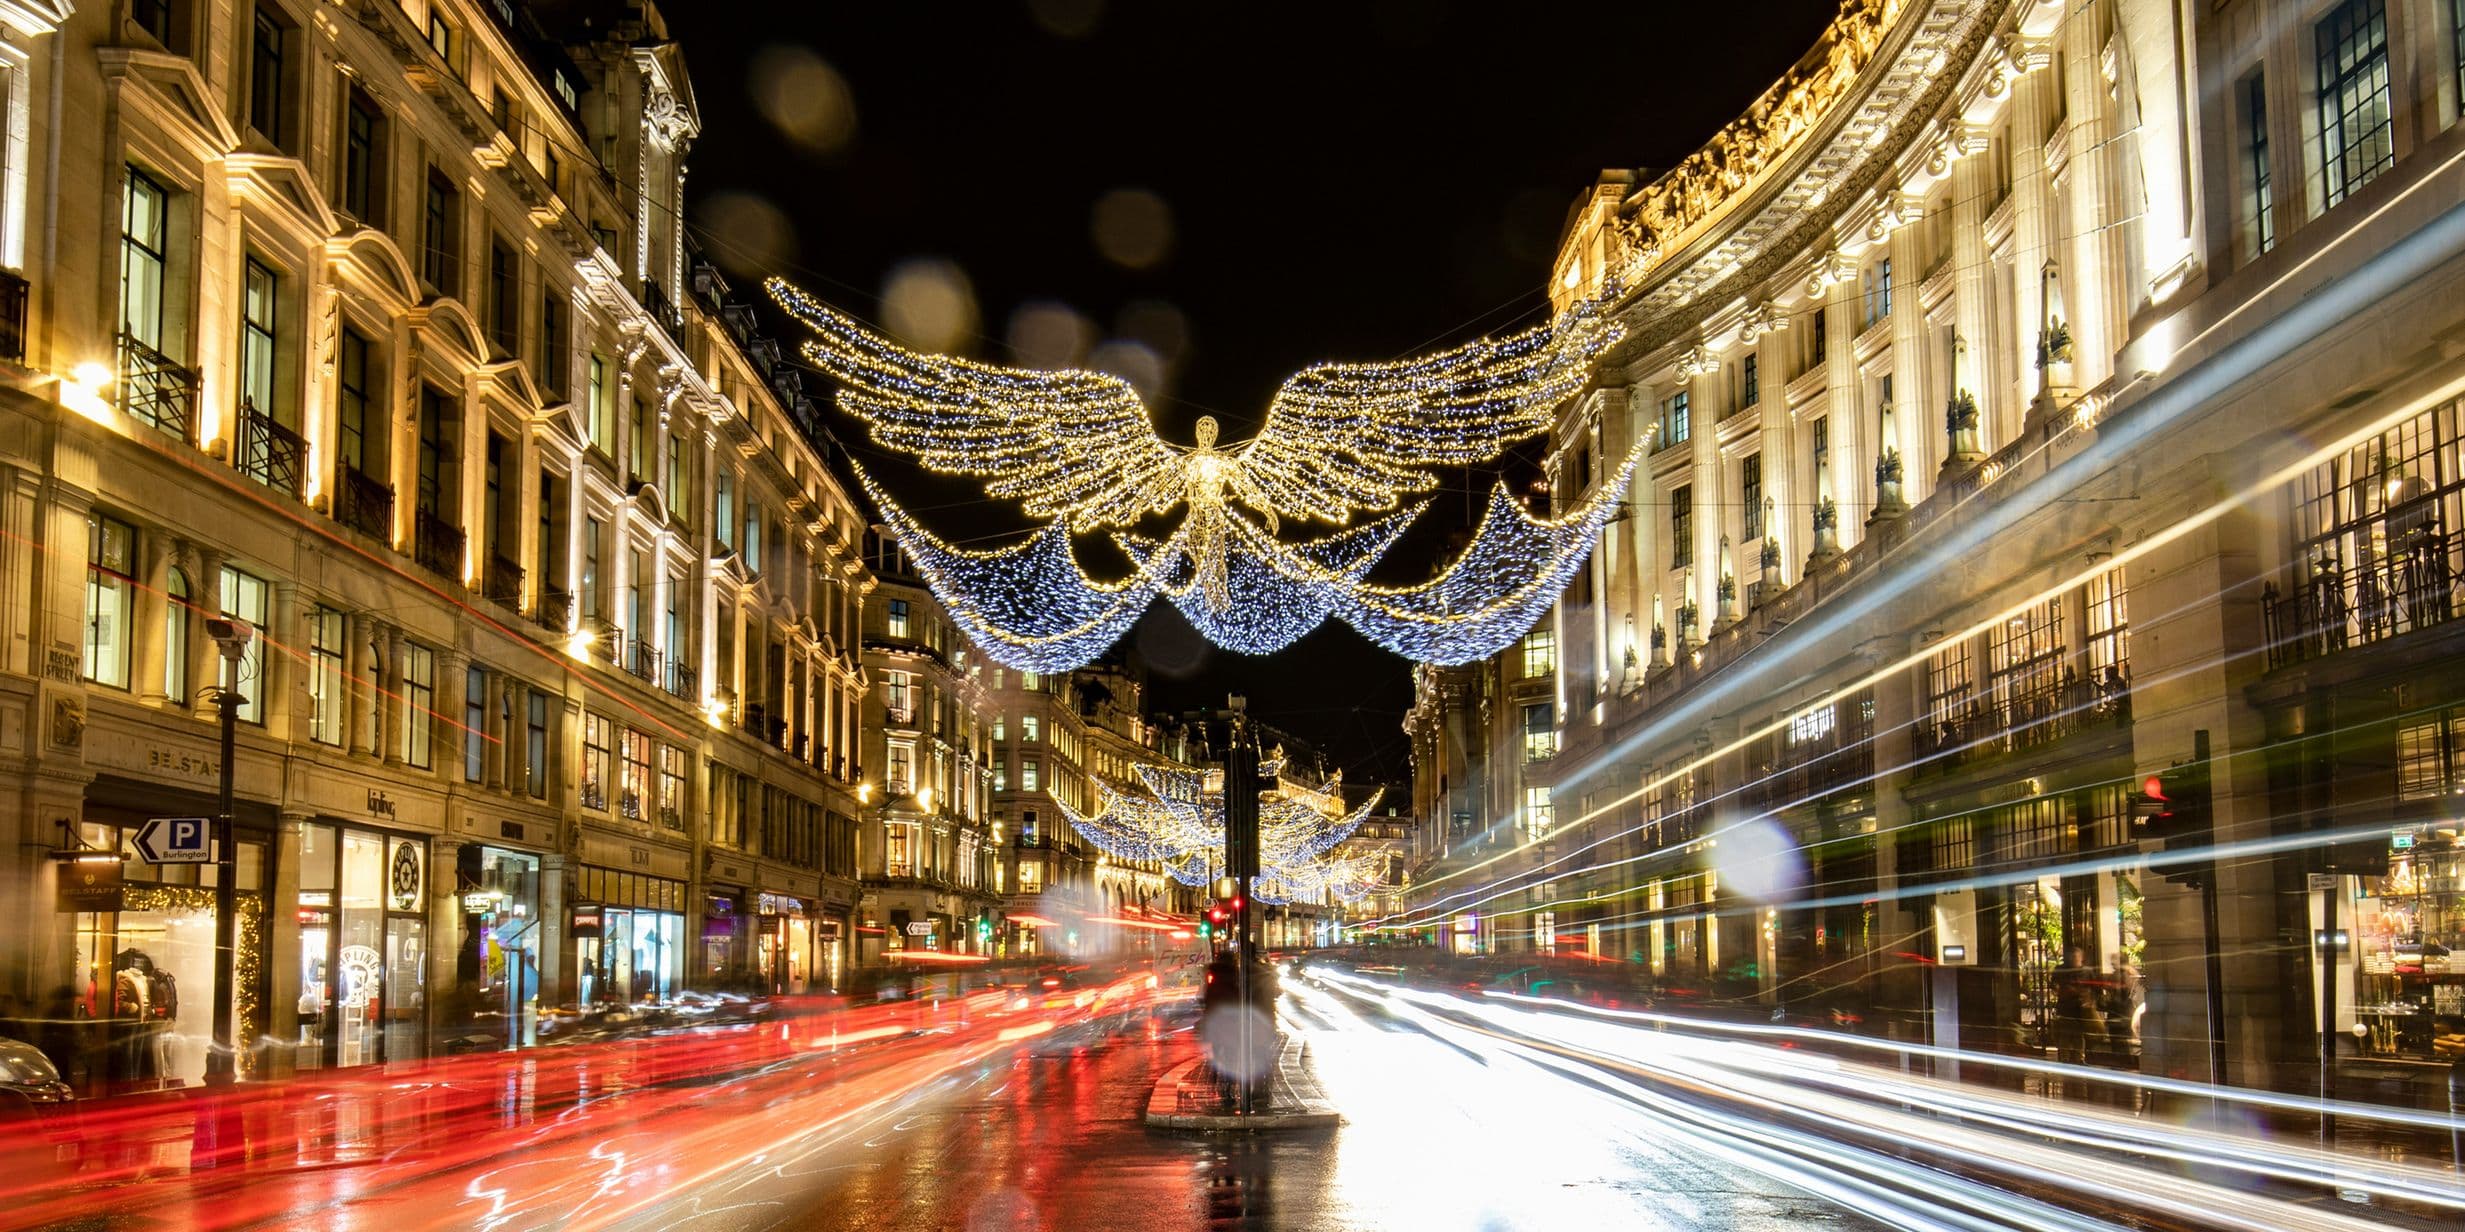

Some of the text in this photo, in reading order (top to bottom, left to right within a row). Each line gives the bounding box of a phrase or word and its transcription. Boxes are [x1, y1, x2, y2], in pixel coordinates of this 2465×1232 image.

[49, 650, 80, 668] REGENT
[46, 664, 74, 683] STREET
[149, 750, 221, 777] BELSTAF
[367, 788, 396, 821] kipling
[175, 822, 195, 847] P
[162, 850, 207, 859] Burlington
